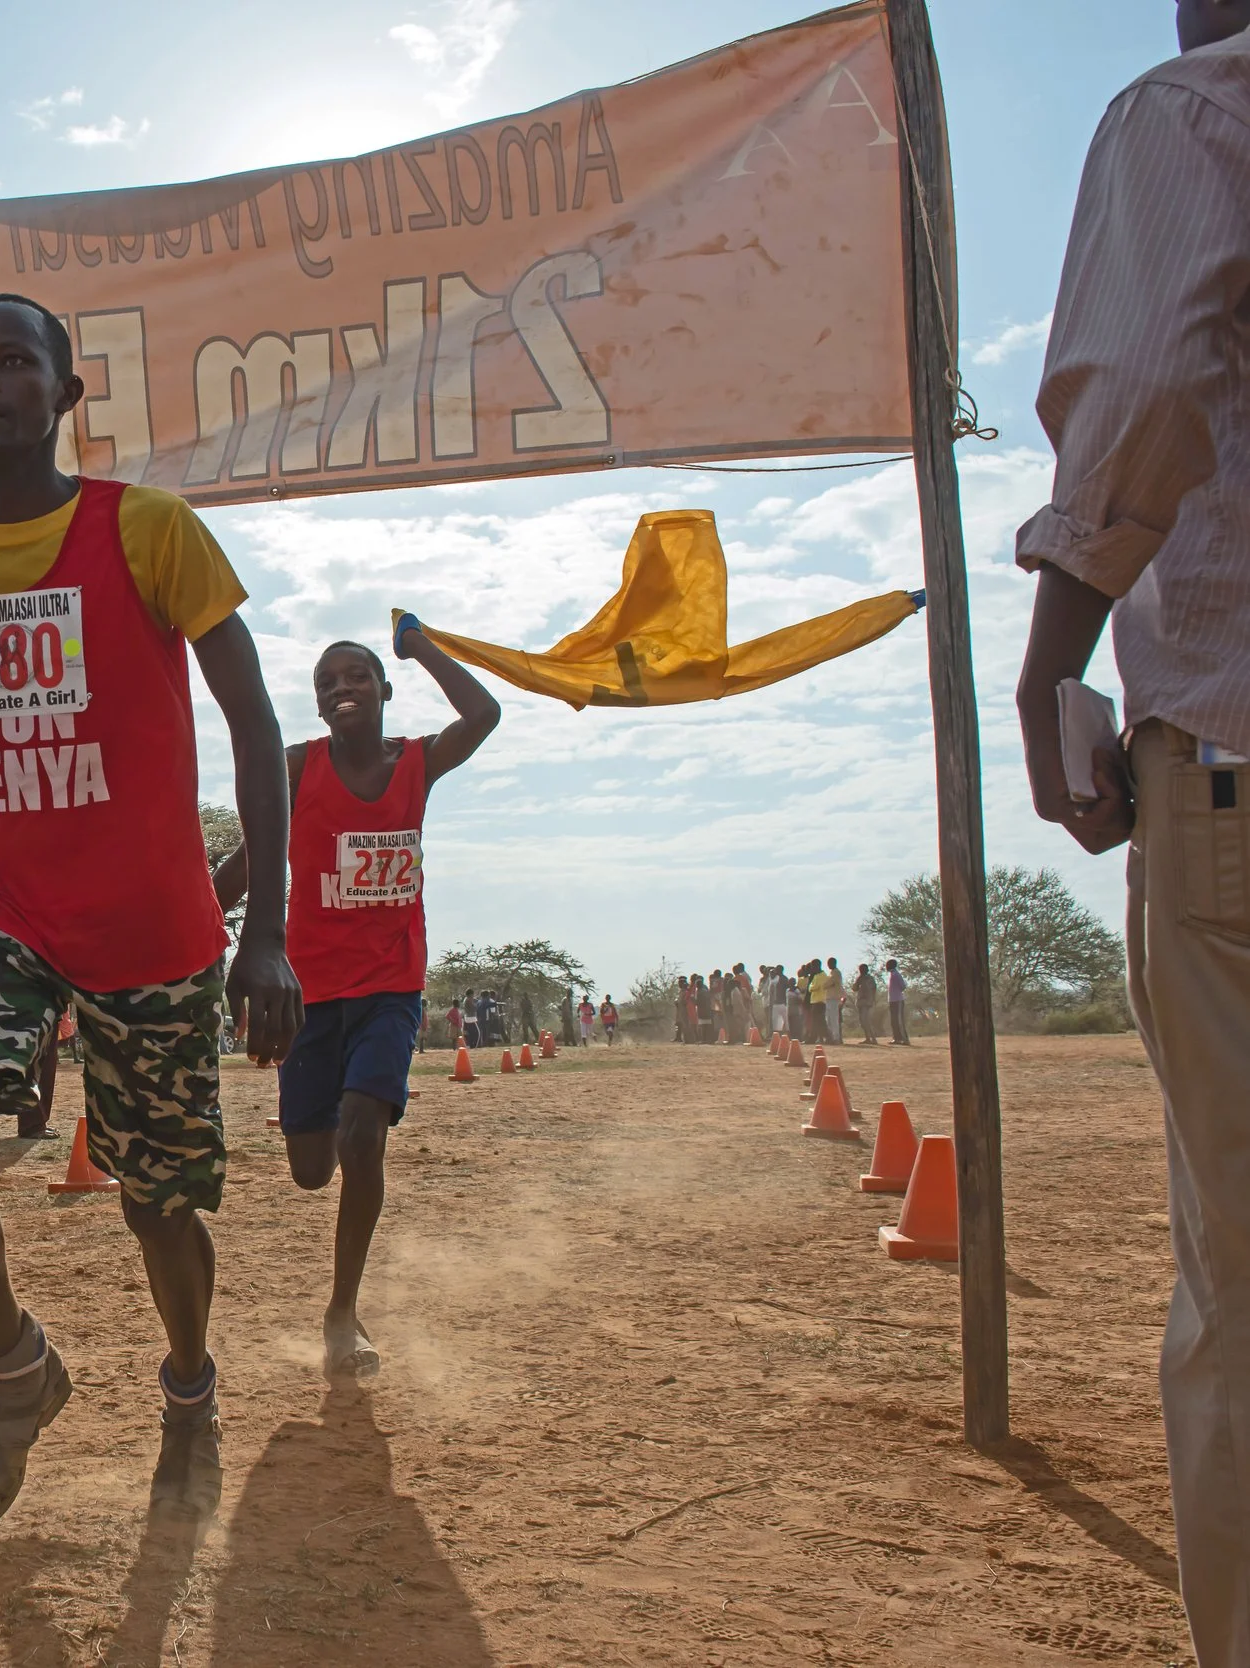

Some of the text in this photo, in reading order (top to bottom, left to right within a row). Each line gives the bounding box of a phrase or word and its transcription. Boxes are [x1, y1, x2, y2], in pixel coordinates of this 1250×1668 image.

[39, 593, 70, 618] ULTRA
[28, 692, 41, 707] A
[46, 689, 77, 705] Girl
[348, 833, 416, 848] AMAZING MAASAI ULTRA
[354, 848, 414, 887] 272
[347, 883, 416, 896] Educate A Girl
